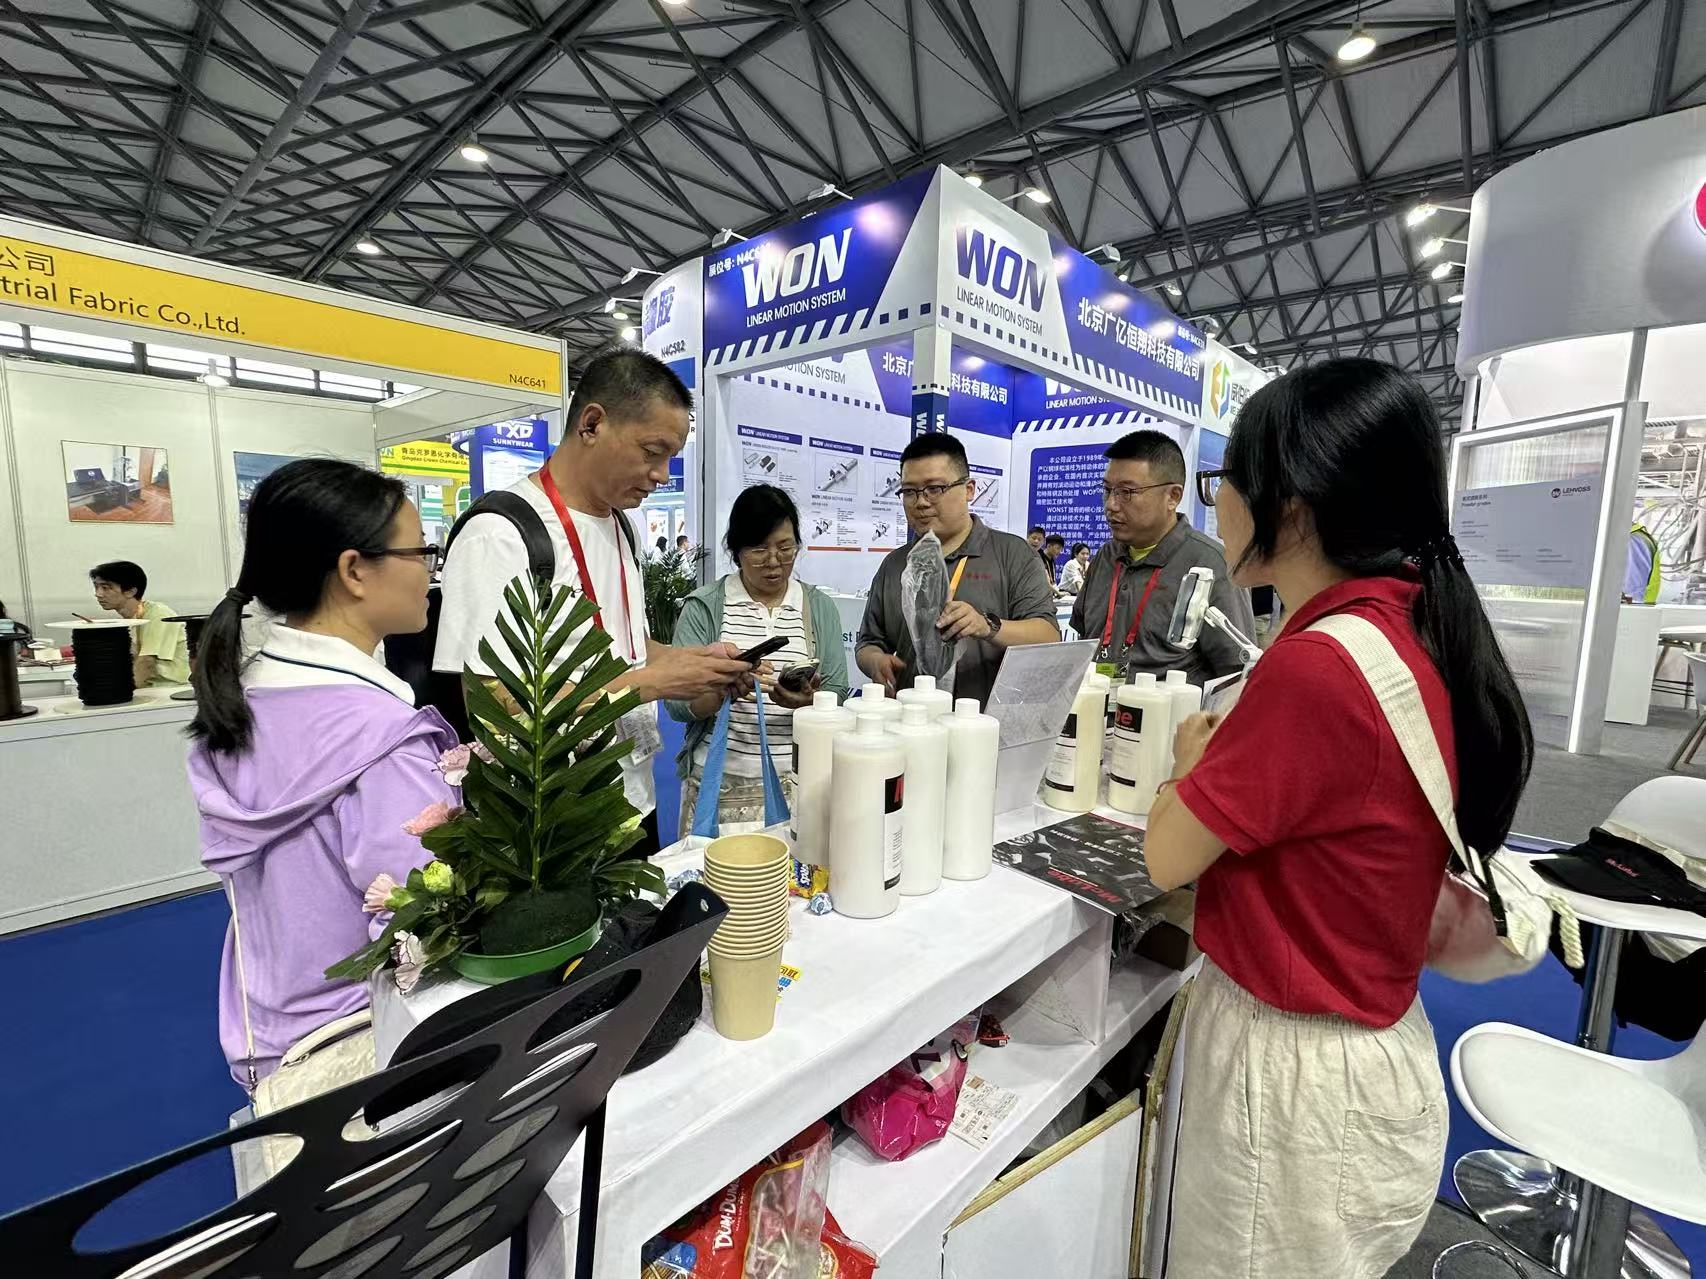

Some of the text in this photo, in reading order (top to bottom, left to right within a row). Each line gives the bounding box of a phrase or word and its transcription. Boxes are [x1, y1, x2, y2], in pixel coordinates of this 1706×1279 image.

[742, 227, 852, 309] WON
[956, 225, 1047, 312] WON
[69, 286, 149, 319] Fabric
[157, 304, 246, 335] Co.,Ltd.
[746, 288, 846, 328] LINEAR MOTION SYSTEM
[957, 285, 1043, 337] LINEAR MOTION SYSTEM
[1078, 297, 1200, 381] 北京广亿恒翔科技有限公司
[509, 373, 546, 388] N4C641
[815, 366, 846, 384] SYSTEM
[951, 373, 1008, 405] 科技有限公司
[1045, 398, 1067, 410] LINEAR
[1069, 395, 1098, 407] MOTION
[492, 437, 534, 449] SUNNYWEAR
